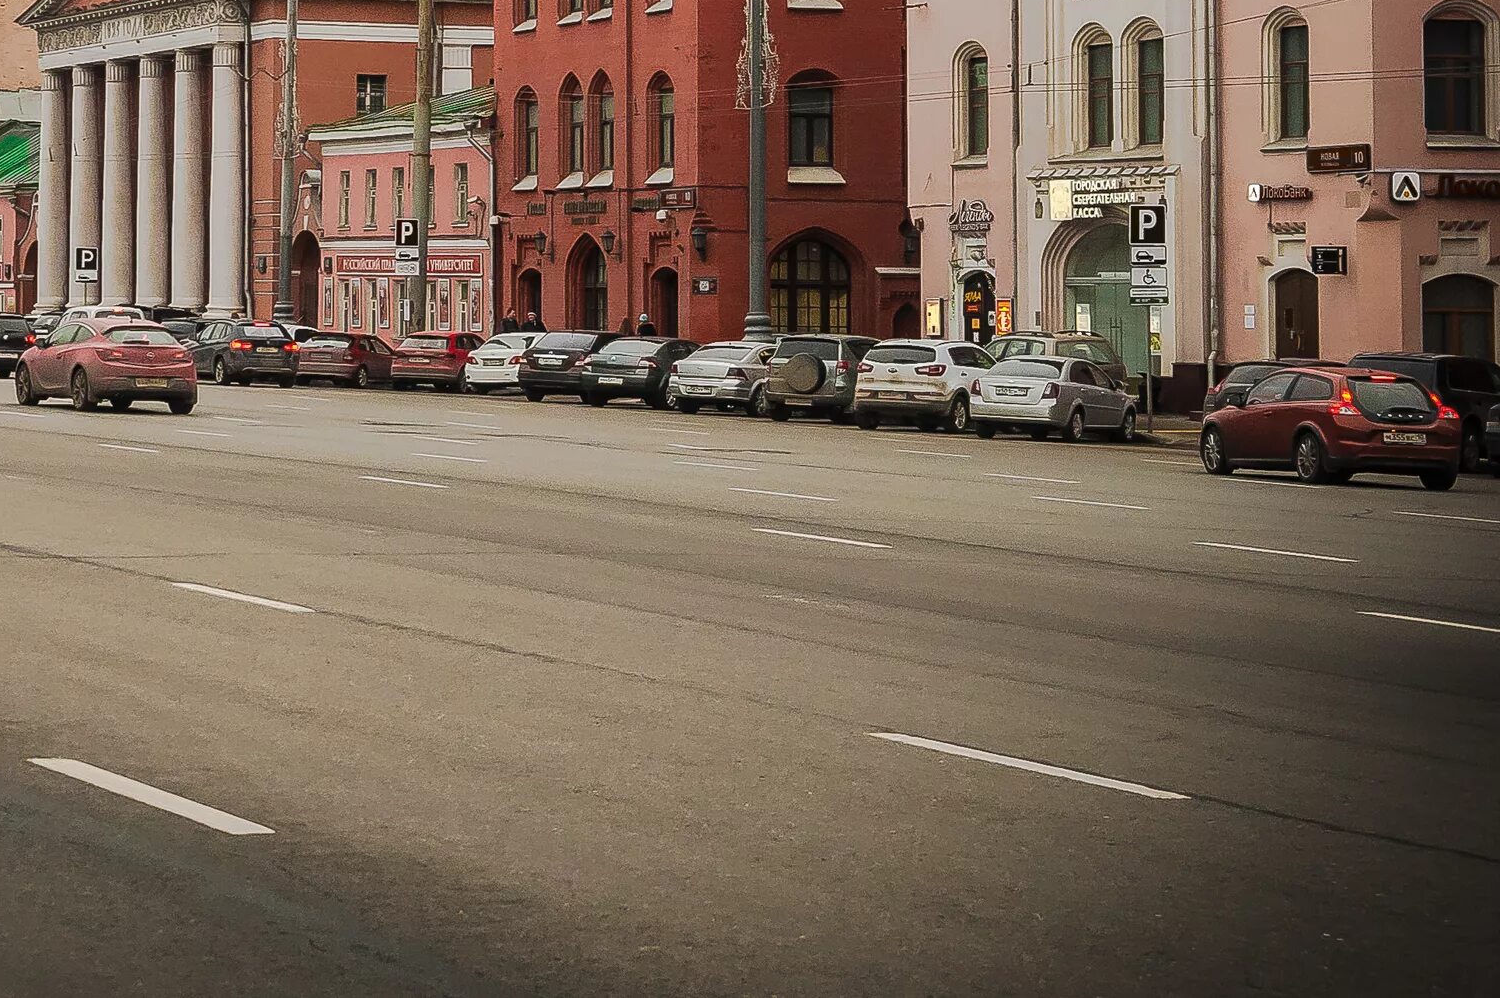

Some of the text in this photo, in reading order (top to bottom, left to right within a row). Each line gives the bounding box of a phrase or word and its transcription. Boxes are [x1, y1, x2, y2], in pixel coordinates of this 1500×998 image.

[1354, 151, 1364, 163] 10
[1072, 179, 1118, 192] ГОРОДСКАЯ
[1072, 191, 1136, 205] СБЕРЕГАТЕЛЬНАЯ
[1073, 207, 1104, 219] КАССА
[1138, 209, 1157, 240] P
[401, 221, 414, 244] P
[81, 249, 94, 268] P
[429, 259, 474, 271] УНИВЕРСИТЕТ
